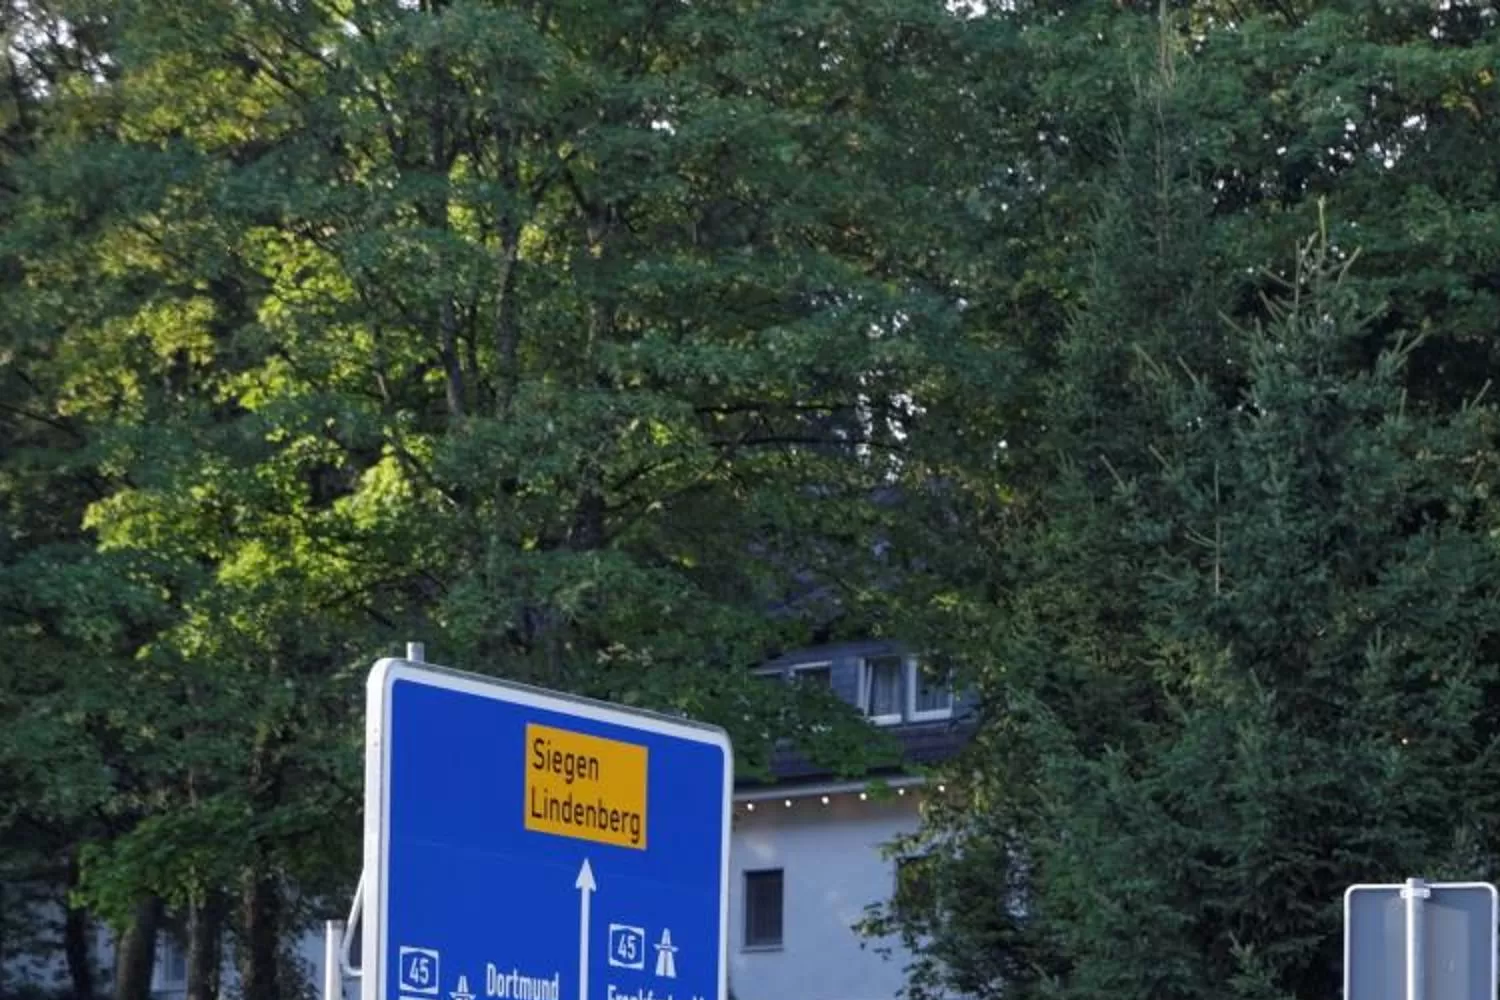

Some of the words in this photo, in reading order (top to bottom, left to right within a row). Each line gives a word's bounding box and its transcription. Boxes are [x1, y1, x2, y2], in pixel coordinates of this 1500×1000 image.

[532, 737, 599, 785] Siegen
[531, 784, 641, 844] Lindenberg
[617, 933, 637, 961] 45
[409, 955, 430, 985] 45
